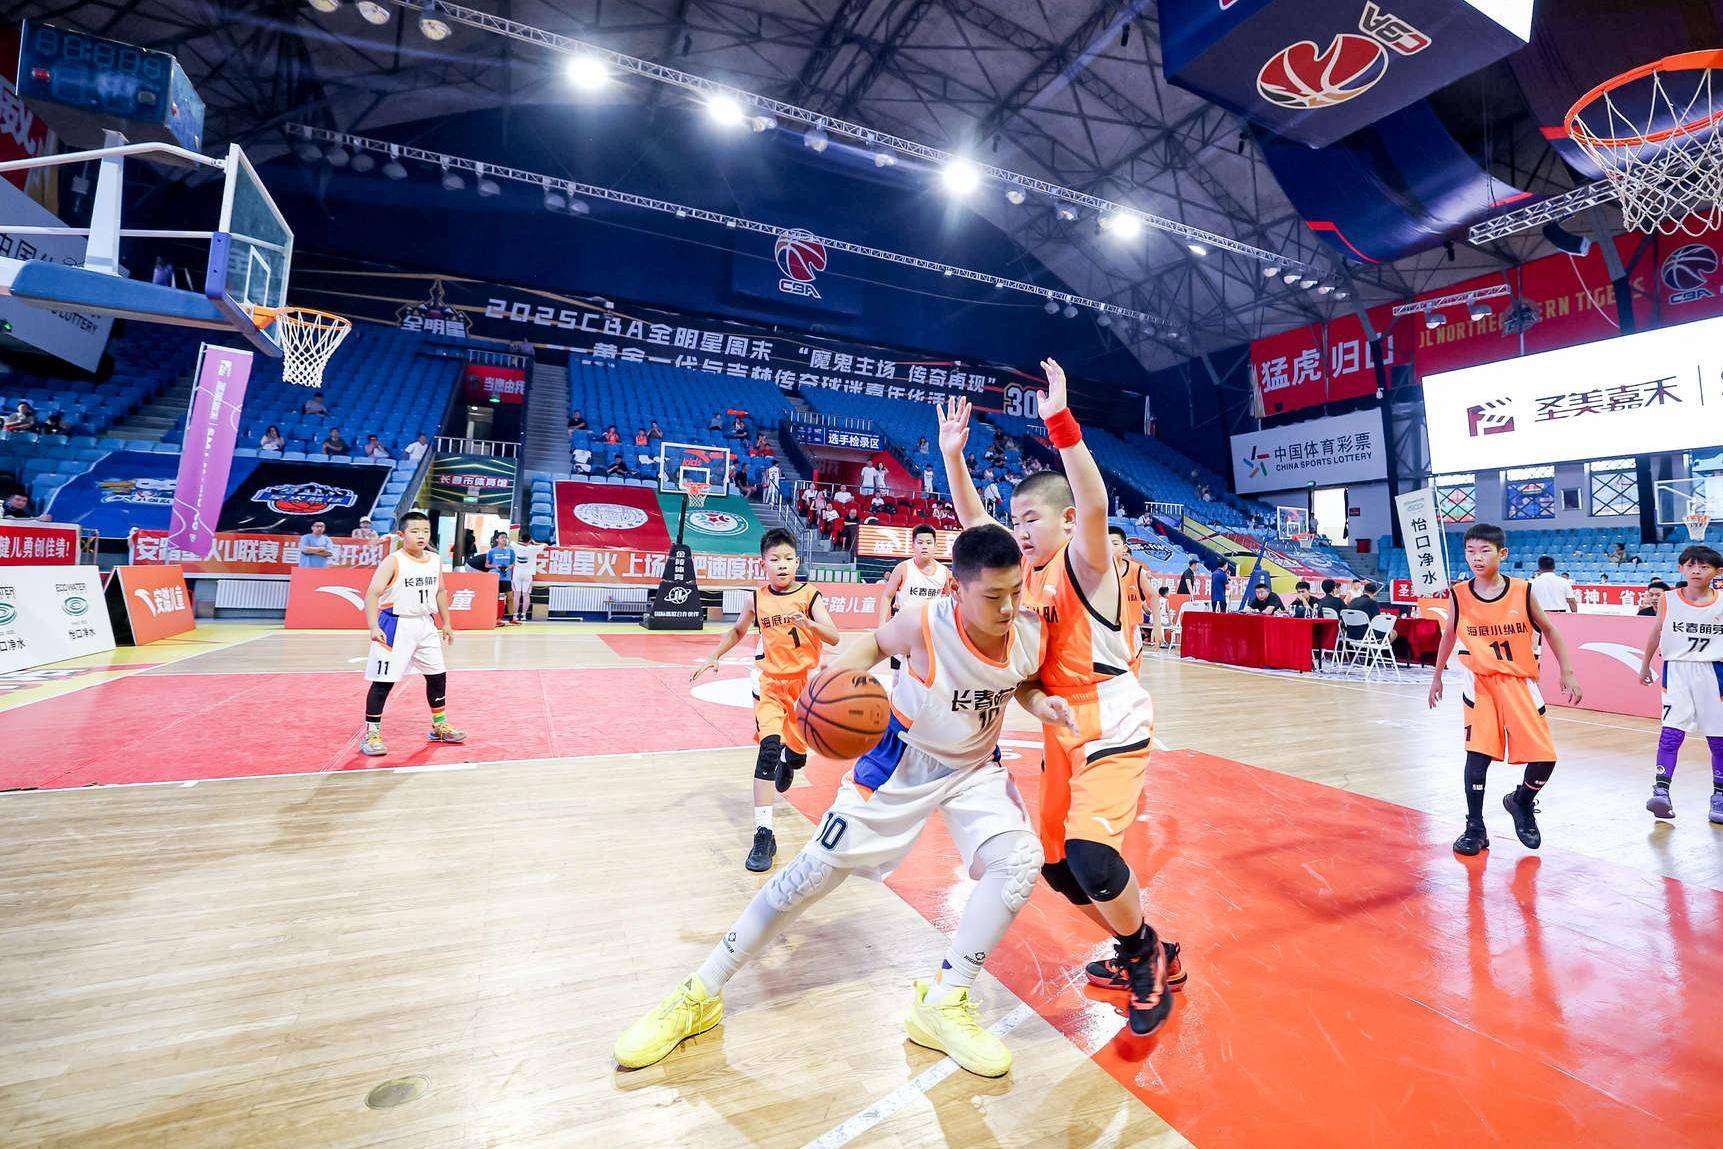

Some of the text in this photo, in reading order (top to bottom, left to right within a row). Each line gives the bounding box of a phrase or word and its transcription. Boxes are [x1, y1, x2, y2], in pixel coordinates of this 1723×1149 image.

[1359, 1, 1432, 55] CBA
[779, 279, 822, 299] CBA
[1575, 276, 1645, 312] TIGES
[1669, 288, 1715, 305] CBA
[485, 298, 773, 362] 2025CBA全明星周末
[1534, 375, 1683, 423] 圣美嘉禾
[828, 433, 880, 449] 选手检录区
[1274, 431, 1372, 462] 中国体育彩票
[1276, 451, 1373, 472] CHINA SPORTS LOTTERY
[1411, 517, 1437, 585] 怡口净水
[418, 589, 429, 604] 11
[788, 626, 801, 649] 1
[1687, 636, 1711, 653] 77
[1489, 639, 1514, 662] 11
[377, 660, 389, 676] 11
[1663, 704, 1672, 721] 7
[1464, 724, 1472, 742] 1
[816, 811, 849, 850] 10
